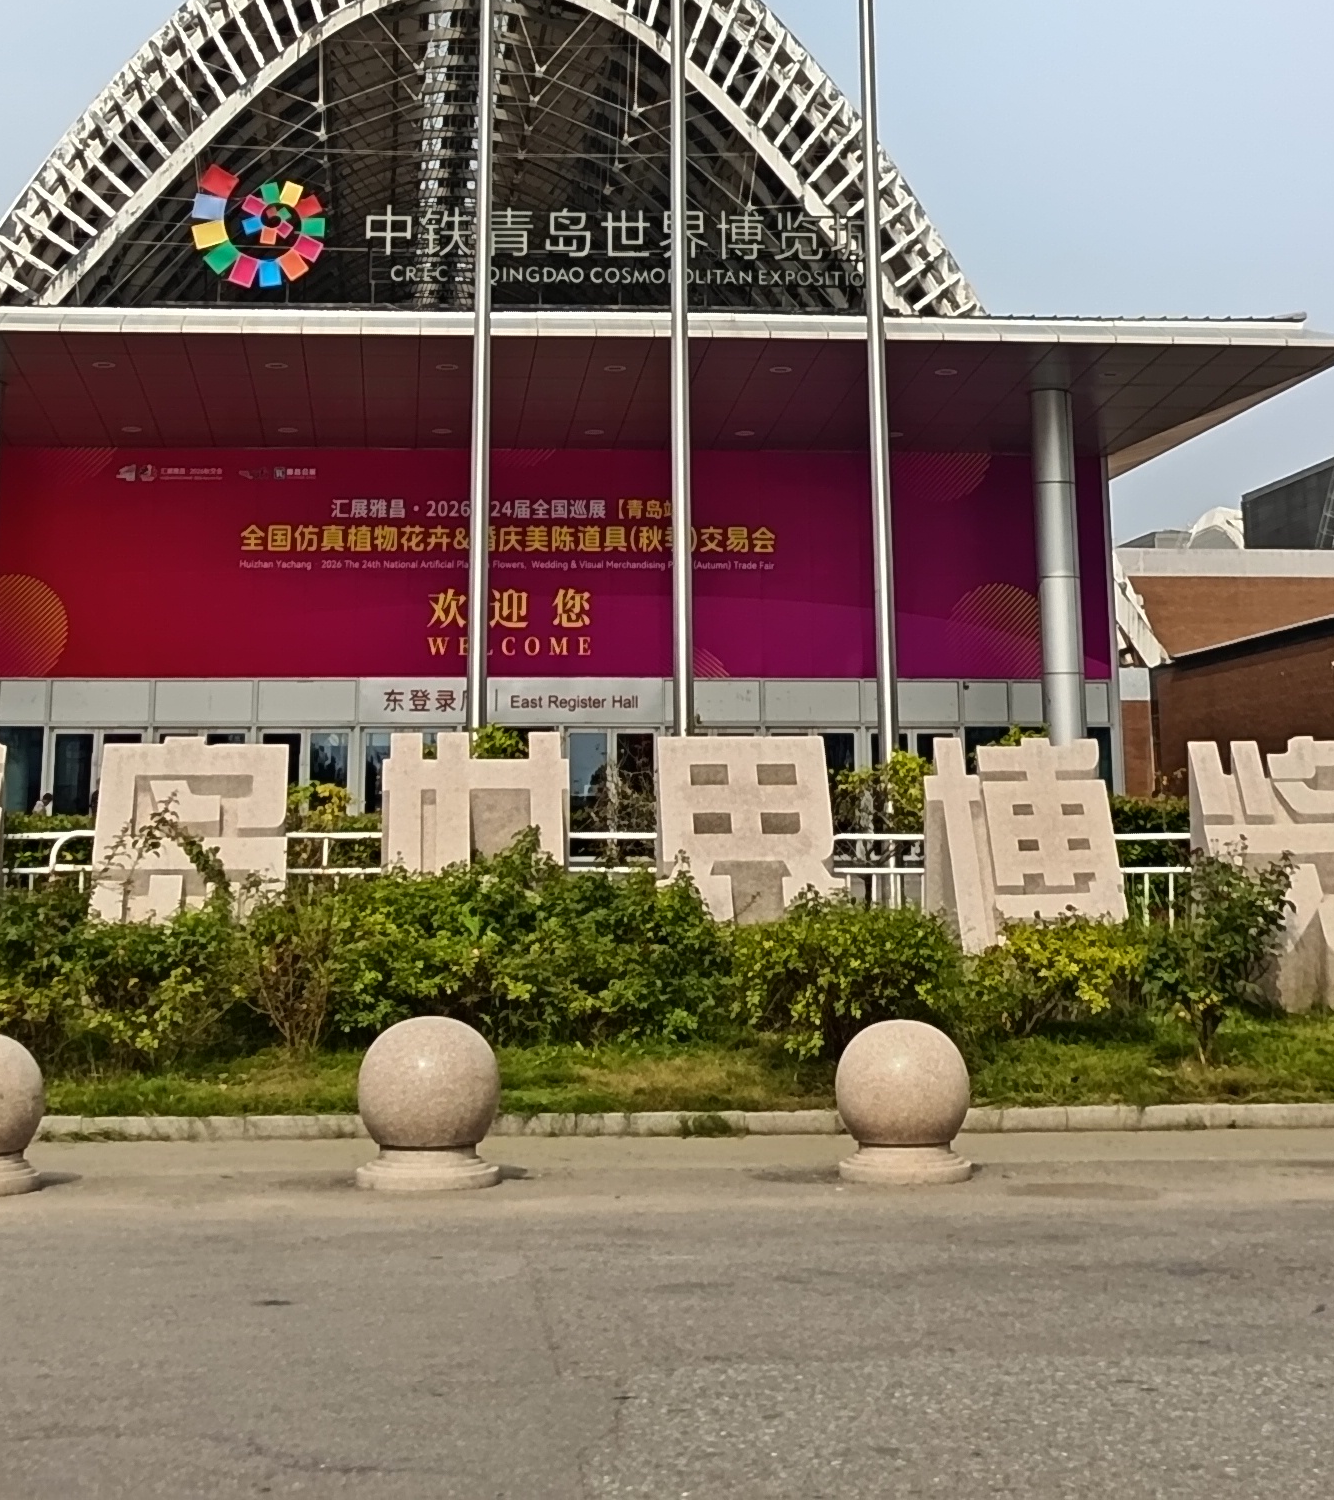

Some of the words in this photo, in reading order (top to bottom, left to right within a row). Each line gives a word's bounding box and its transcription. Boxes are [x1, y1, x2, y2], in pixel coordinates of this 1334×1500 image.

[390, 265, 449, 282] CREC
[590, 266, 753, 285] COSMOLITAN
[758, 269, 866, 286] EXPOSITIO
[239, 559, 274, 569] Huizhan
[275, 559, 312, 571] Yachang
[321, 560, 342, 569] 2026
[345, 560, 360, 569] The
[361, 560, 382, 569] 24th
[383, 559, 418, 569] National
[420, 559, 455, 569] Artificial
[531, 559, 569, 572] Wedding
[570, 560, 578, 570] &
[579, 559, 604, 570] Visual
[606, 559, 666, 572] Merchandising
[693, 560, 732, 571] (Autumn)
[734, 560, 758, 570] Trade
[759, 561, 775, 570] Fair
[426, 588, 592, 629] 欢迎您
[510, 694, 543, 709] East
[548, 694, 607, 712] Register
[612, 694, 639, 709] Hall
